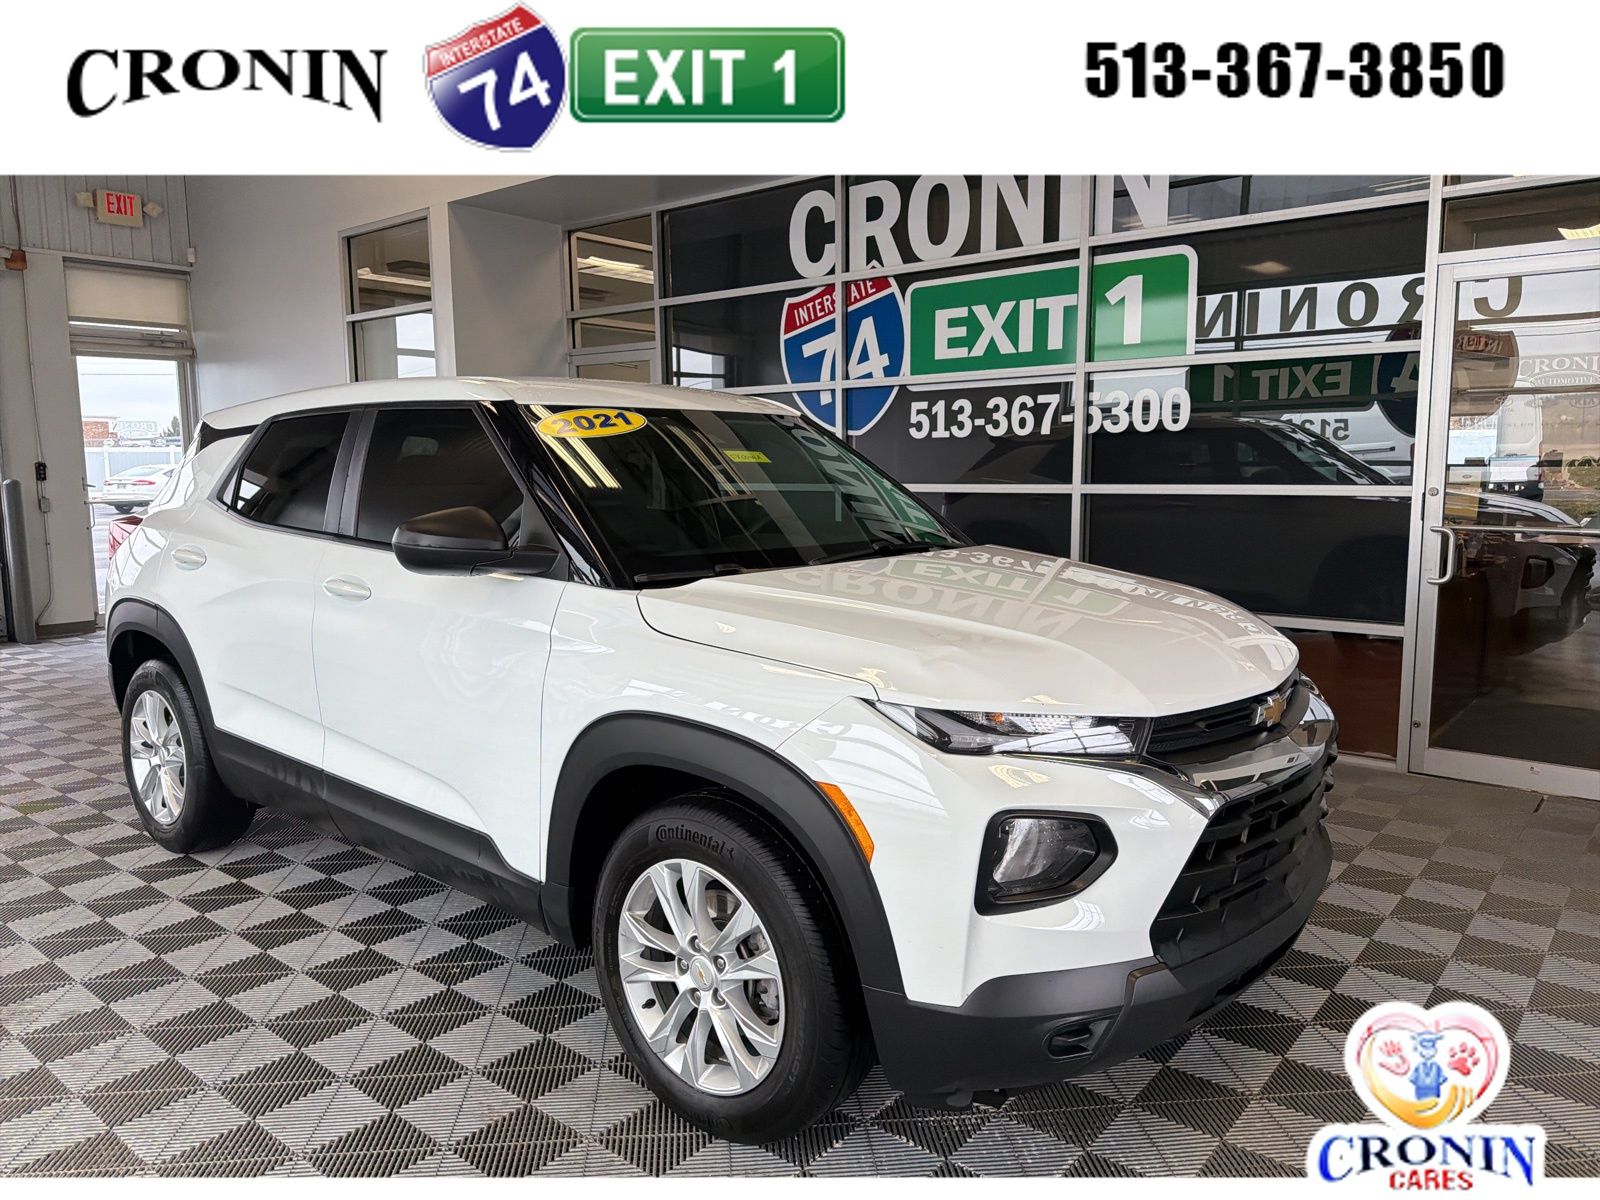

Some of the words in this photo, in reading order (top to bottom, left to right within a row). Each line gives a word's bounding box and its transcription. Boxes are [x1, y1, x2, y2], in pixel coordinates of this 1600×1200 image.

[105, 192, 135, 217] EXIT
[788, 174, 1169, 279] CRONIN
[934, 293, 1078, 361] EXIT
[1105, 275, 1144, 345] 1
[801, 315, 890, 406] 74
[551, 411, 633, 435] 2021
[655, 824, 727, 856] Continental
